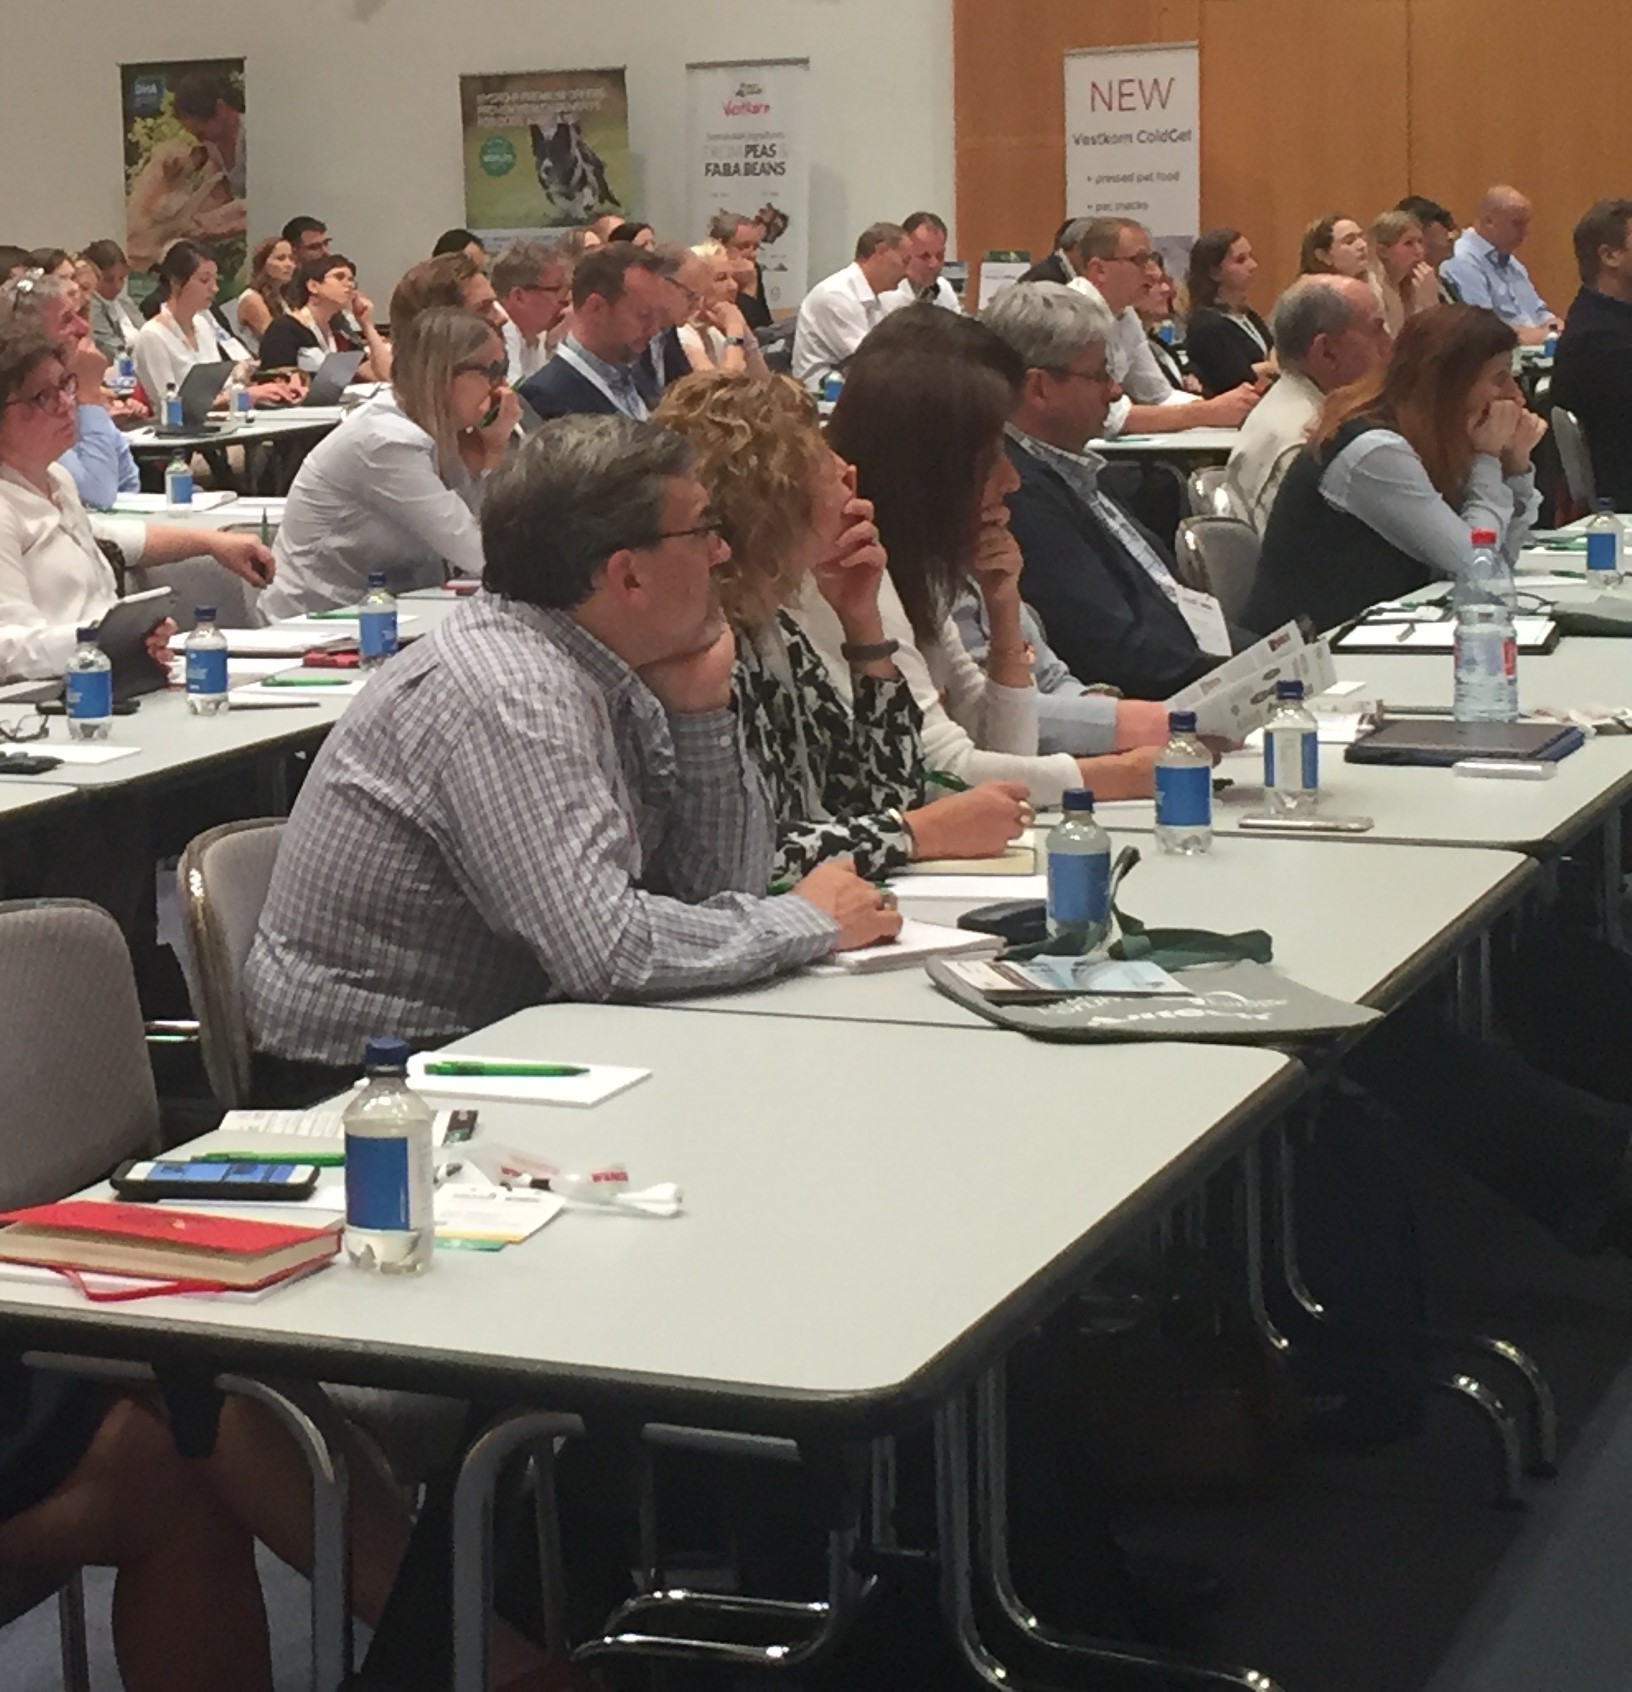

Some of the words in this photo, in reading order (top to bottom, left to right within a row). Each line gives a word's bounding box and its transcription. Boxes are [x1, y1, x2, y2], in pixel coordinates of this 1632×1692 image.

[1089, 76, 1176, 112] NEW
[744, 143, 777, 159] PEAS
[704, 162, 741, 177] FABA
[743, 160, 786, 177] BEANS
